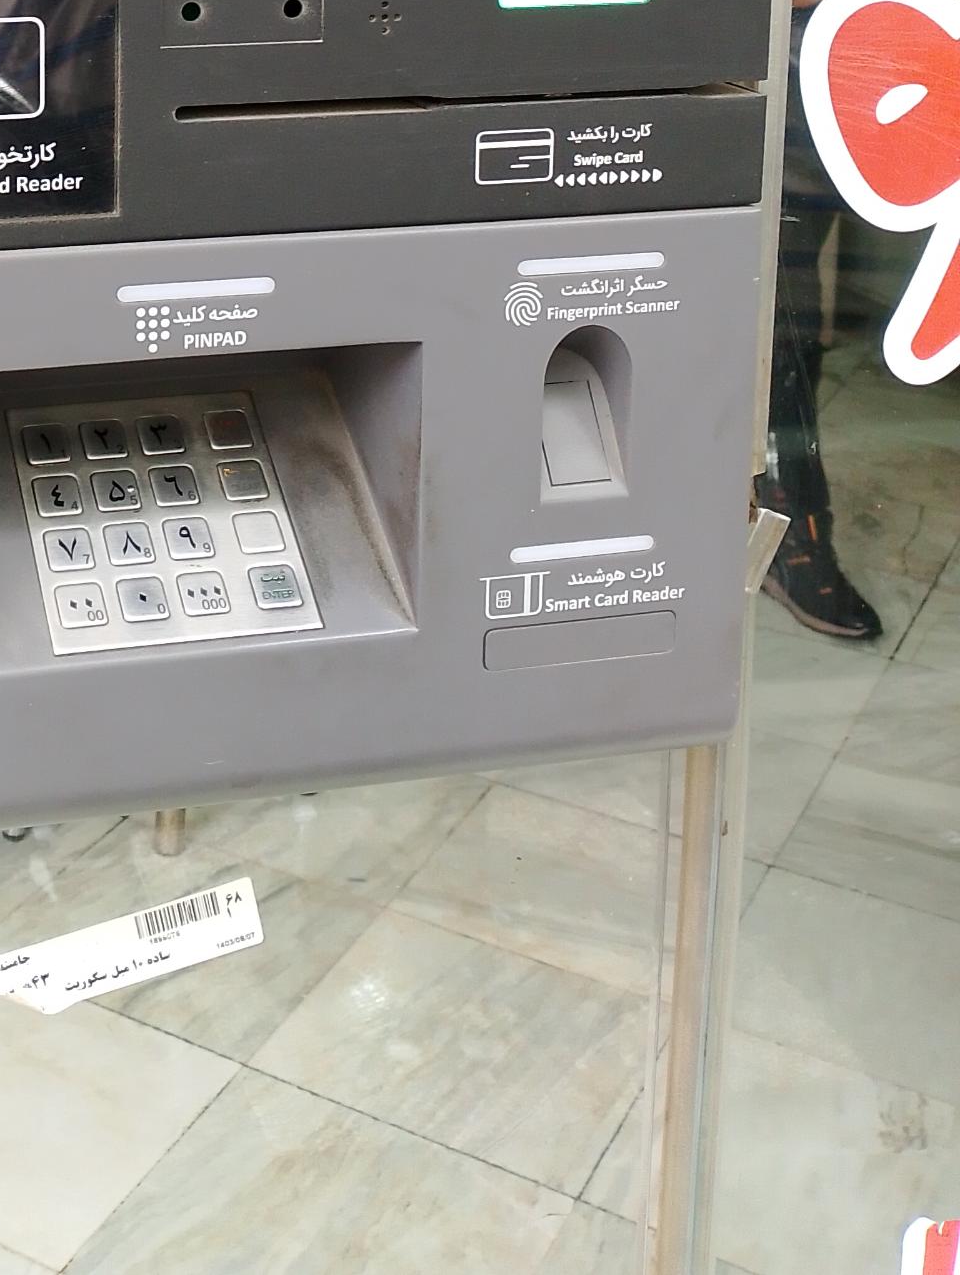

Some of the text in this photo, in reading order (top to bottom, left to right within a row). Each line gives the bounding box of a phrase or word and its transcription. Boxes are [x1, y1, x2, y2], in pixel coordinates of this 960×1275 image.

[566, 123, 653, 144] کارت را بکشید
[573, 150, 644, 168] Swipe Card
[15, 173, 84, 194] Reader
[626, 275, 669, 297] حسگر
[172, 303, 259, 327] صفحه کلید
[546, 299, 681, 321] Fingerprint Scanner
[183, 330, 248, 350] PINPAD
[93, 426, 110, 451] ۲
[149, 423, 168, 447] ۳
[117, 444, 126, 455] 2
[108, 479, 126, 503] ۵
[130, 494, 139, 506] 5
[187, 489, 197, 502] 6
[71, 500, 80, 513] 4
[122, 531, 142, 556] ۸
[178, 525, 197, 550] ۹
[58, 537, 78, 561] ۷
[143, 547, 153, 559] 8
[202, 542, 212, 554] 9
[82, 553, 91, 565] 7
[567, 562, 666, 587] کارت هوشمند
[156, 602, 166, 615] 0
[201, 597, 228, 611] 000
[545, 586, 685, 613] Smart Card Reader
[87, 609, 105, 622] 00
[147, 951, 170, 965] ساده
